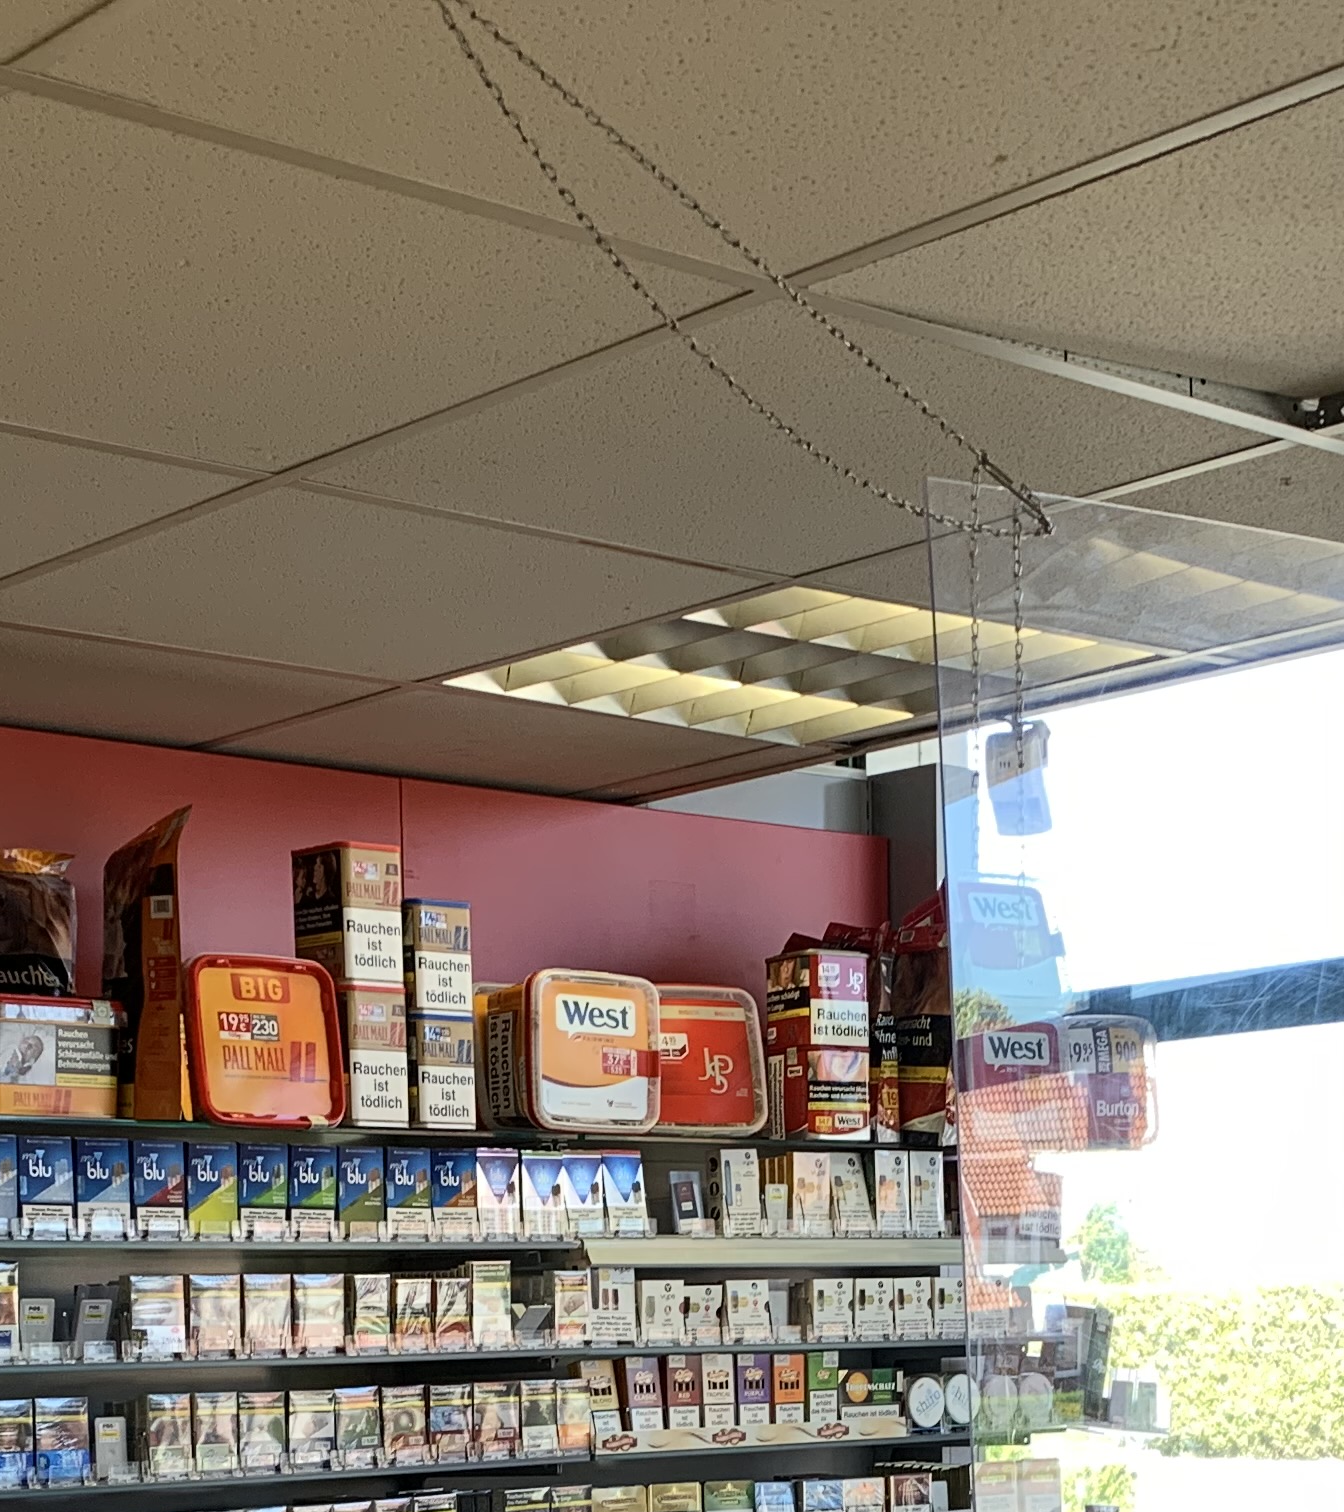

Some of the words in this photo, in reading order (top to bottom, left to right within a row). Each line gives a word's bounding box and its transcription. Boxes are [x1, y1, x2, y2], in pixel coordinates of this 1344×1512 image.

[346, 919, 401, 936] Rauchen
[367, 939, 383, 951] ist
[354, 954, 396, 969] tödlich
[239, 976, 283, 1001] BIG
[561, 999, 630, 1030] West
[987, 1034, 1045, 1060] West
[222, 1045, 252, 1071] PALL
[256, 1046, 287, 1072] MALL
[1096, 1100, 1139, 1118] Burton
